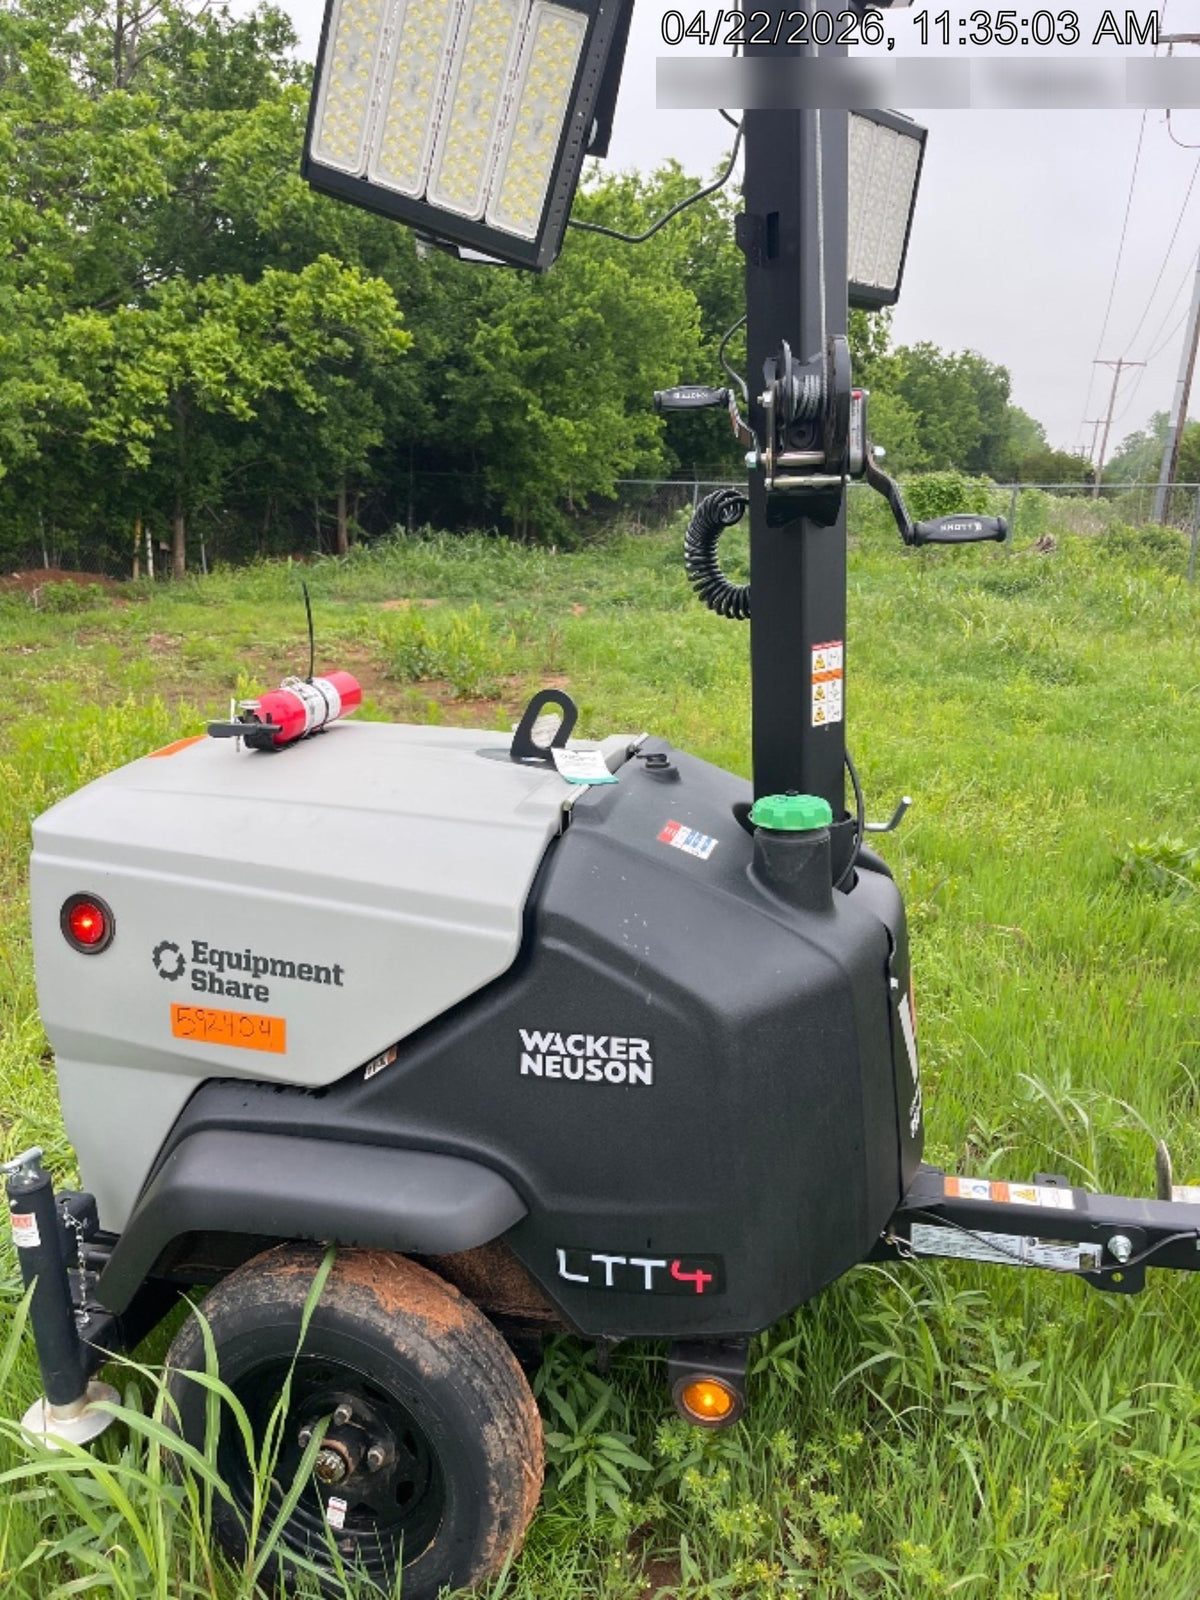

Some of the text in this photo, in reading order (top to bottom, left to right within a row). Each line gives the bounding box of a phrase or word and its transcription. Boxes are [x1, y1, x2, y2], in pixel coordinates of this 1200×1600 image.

[191, 940, 345, 987] Equipment
[191, 968, 270, 1003] Share
[177, 1007, 272, 1039] 592404
[518, 1028, 653, 1062] WACKER
[520, 1052, 653, 1085] NEUSON
[556, 1248, 712, 1293] LTT4
